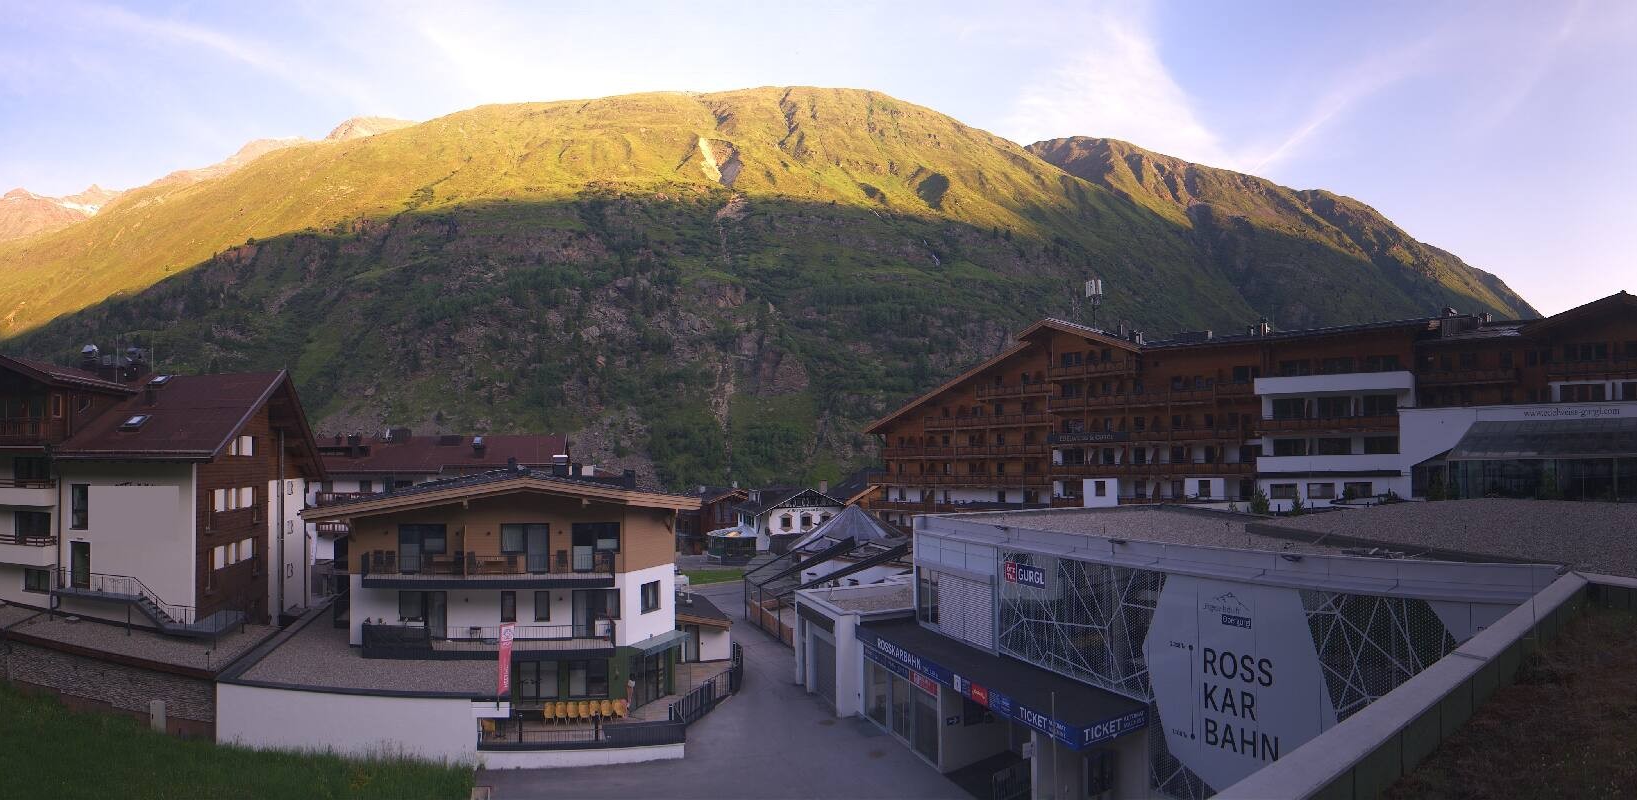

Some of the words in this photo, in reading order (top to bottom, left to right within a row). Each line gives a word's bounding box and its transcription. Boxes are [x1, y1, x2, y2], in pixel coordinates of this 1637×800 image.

[1018, 568, 1045, 585] GURGL
[877, 637, 922, 670] ROSSKARBAHN
[1203, 647, 1273, 687] ROSS
[1019, 706, 1048, 730] TICKET
[1203, 682, 1257, 722] KAR
[1084, 718, 1123, 742] TICKET
[1204, 717, 1279, 762] BAHN
